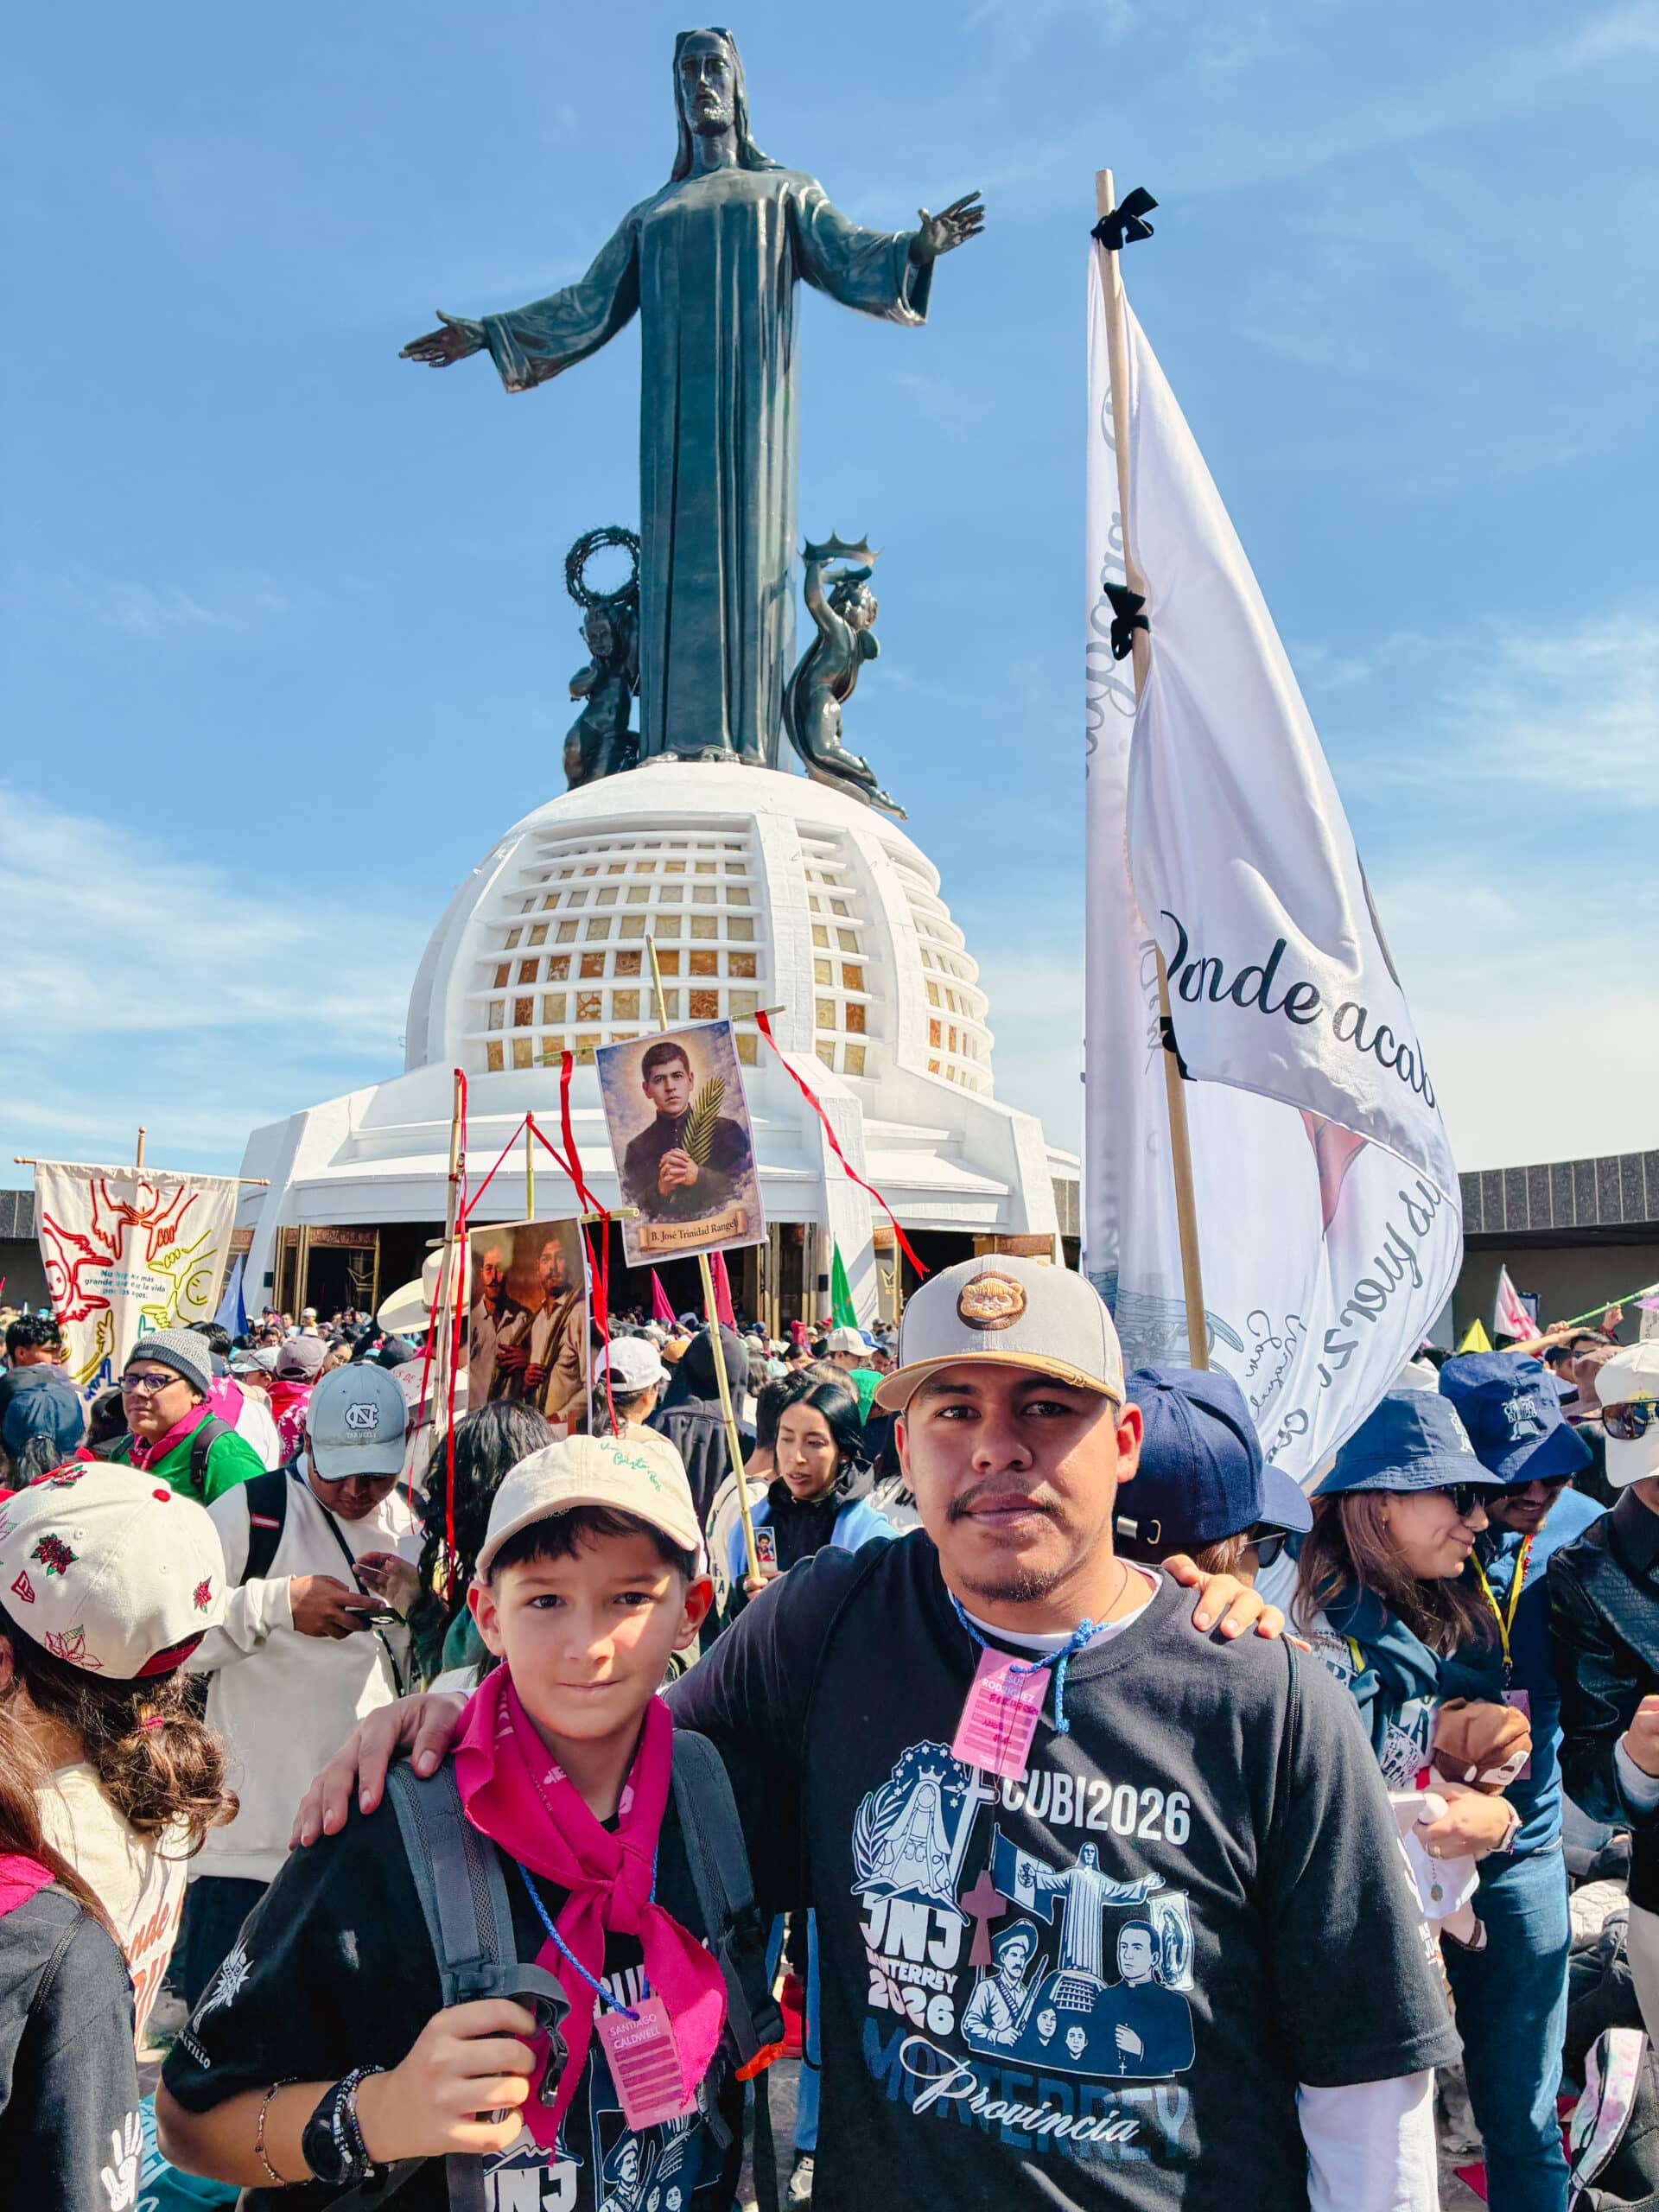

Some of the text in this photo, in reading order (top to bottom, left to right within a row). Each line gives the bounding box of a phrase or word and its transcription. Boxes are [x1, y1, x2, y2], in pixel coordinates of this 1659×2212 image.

[1332, 1001, 1436, 1109] acab
[661, 1230, 677, 1243] José
[677, 1226, 709, 1239] Trinidad
[711, 1217, 738, 1233] Rangel
[1001, 1768, 1191, 1846] CUBI2026
[859, 1891, 963, 1970] JNJ
[865, 1945, 959, 1994] MTERREY
[608, 2013, 657, 2037] SANTIAGO
[868, 1968, 955, 2036] 2026
[179, 2028, 211, 2069] ALTILLO
[613, 2026, 661, 2050] CALDWELL
[899, 2036, 1140, 2143] Provincia
